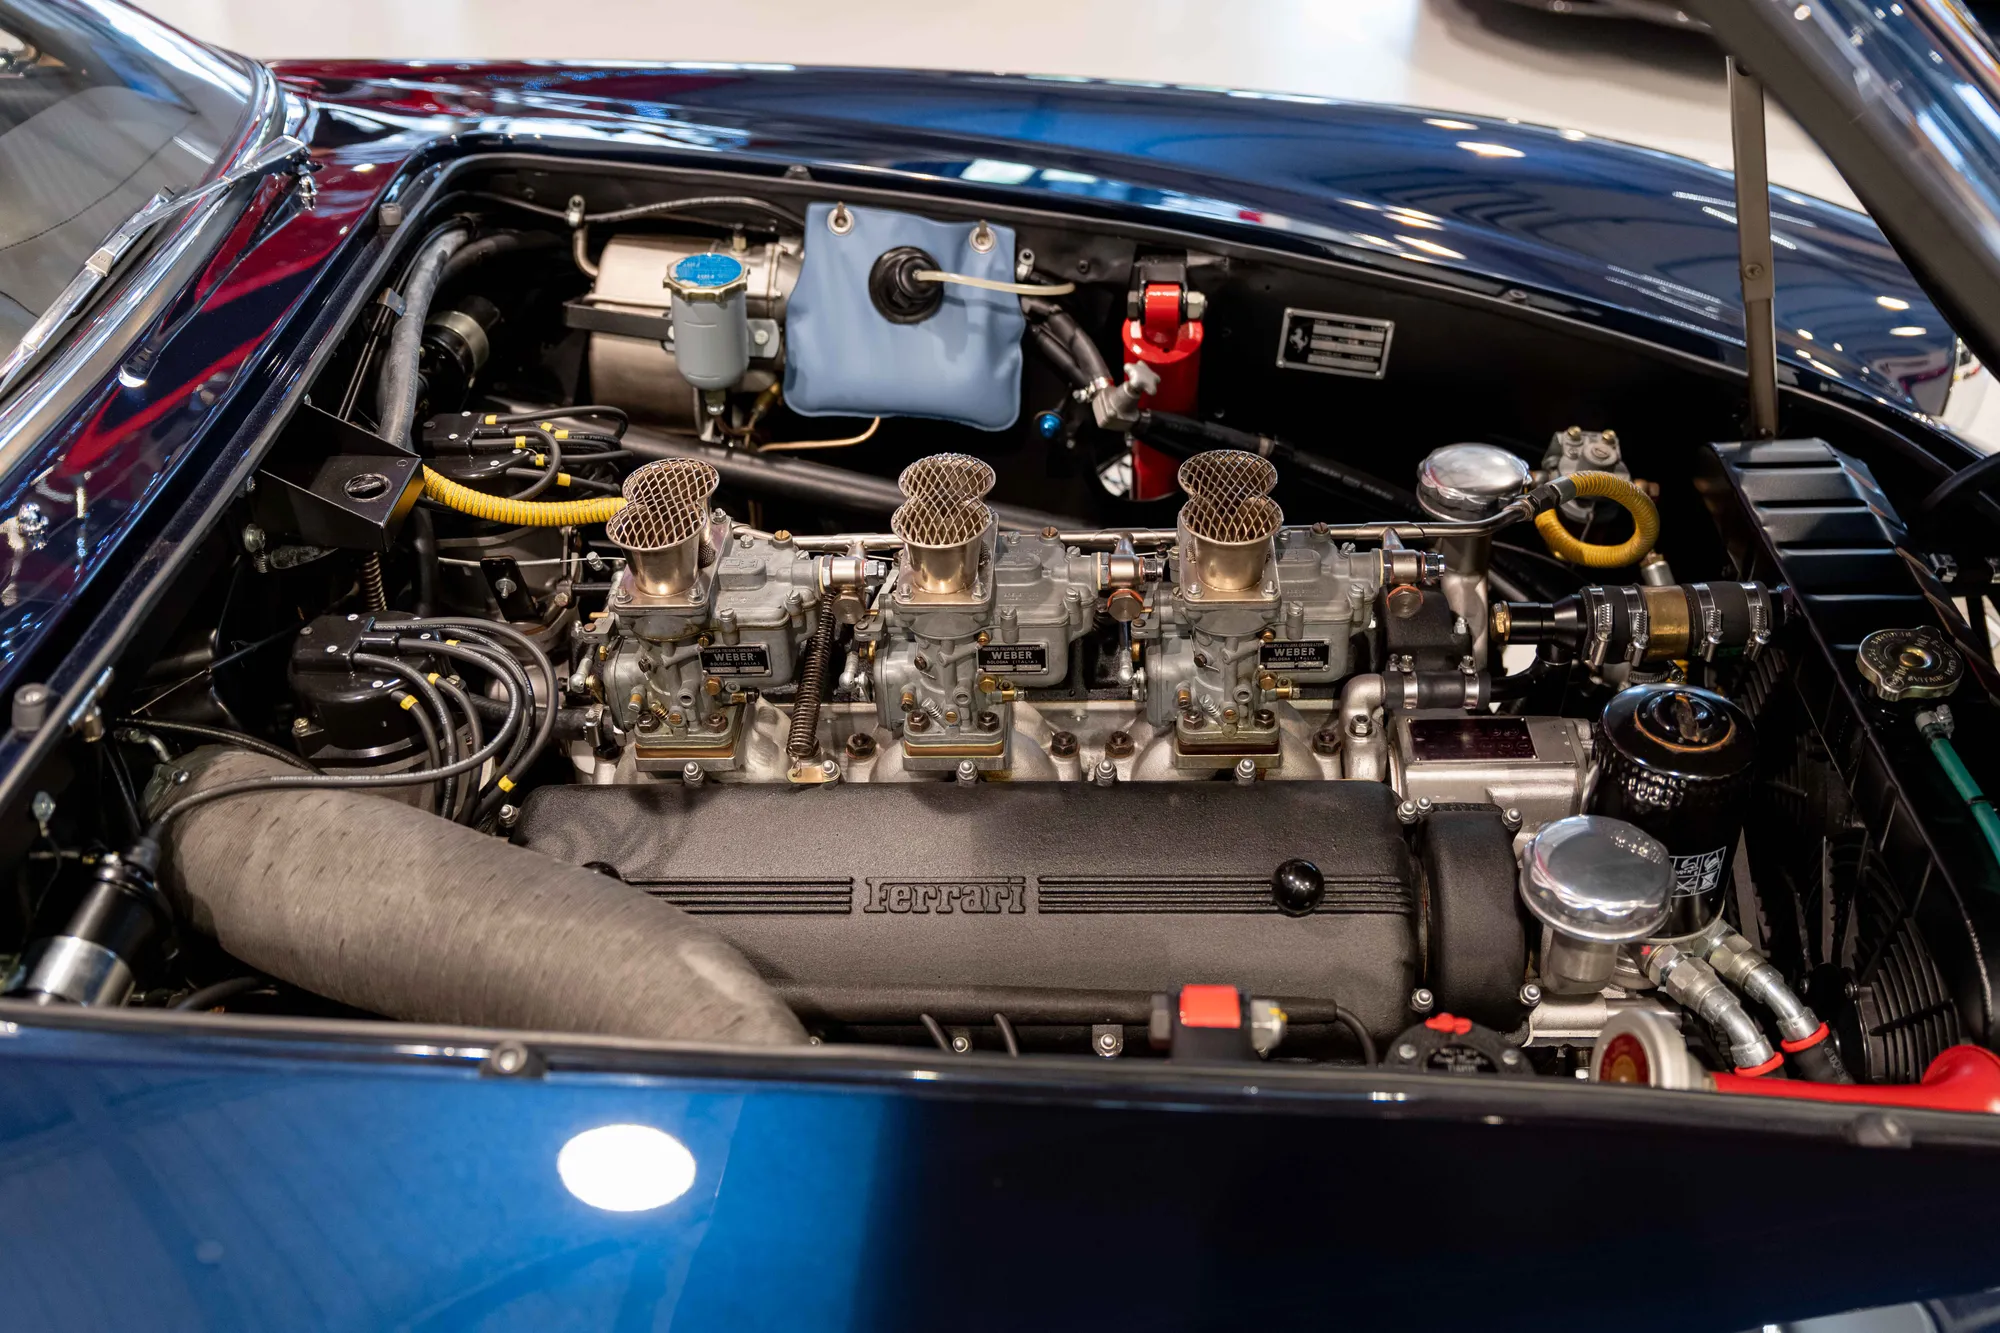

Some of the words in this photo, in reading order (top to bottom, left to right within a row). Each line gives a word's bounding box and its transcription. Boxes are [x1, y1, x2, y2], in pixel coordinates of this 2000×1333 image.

[991, 651, 1032, 660] WEBER
[1274, 648, 1316, 656] WEBER
[714, 652, 754, 662] WEBER
[863, 876, 1026, 914] Ferrari
